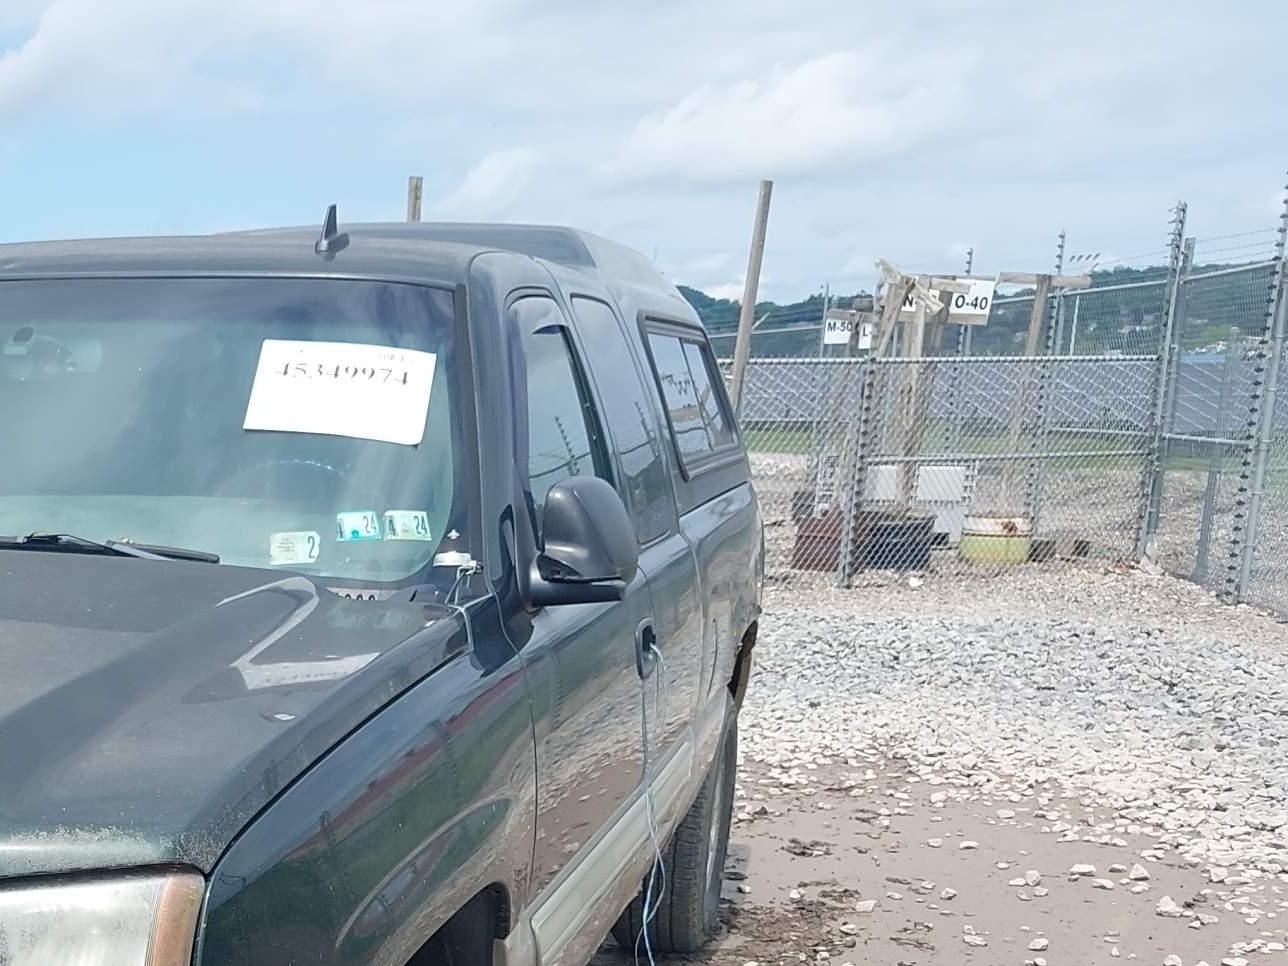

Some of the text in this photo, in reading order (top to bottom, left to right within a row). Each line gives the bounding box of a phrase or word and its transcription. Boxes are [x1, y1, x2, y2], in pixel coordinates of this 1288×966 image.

[955, 294, 989, 310] O-40
[826, 320, 853, 333] M-50
[363, 514, 377, 534] 24
[414, 514, 428, 536] 24
[307, 536, 316, 560] 2
